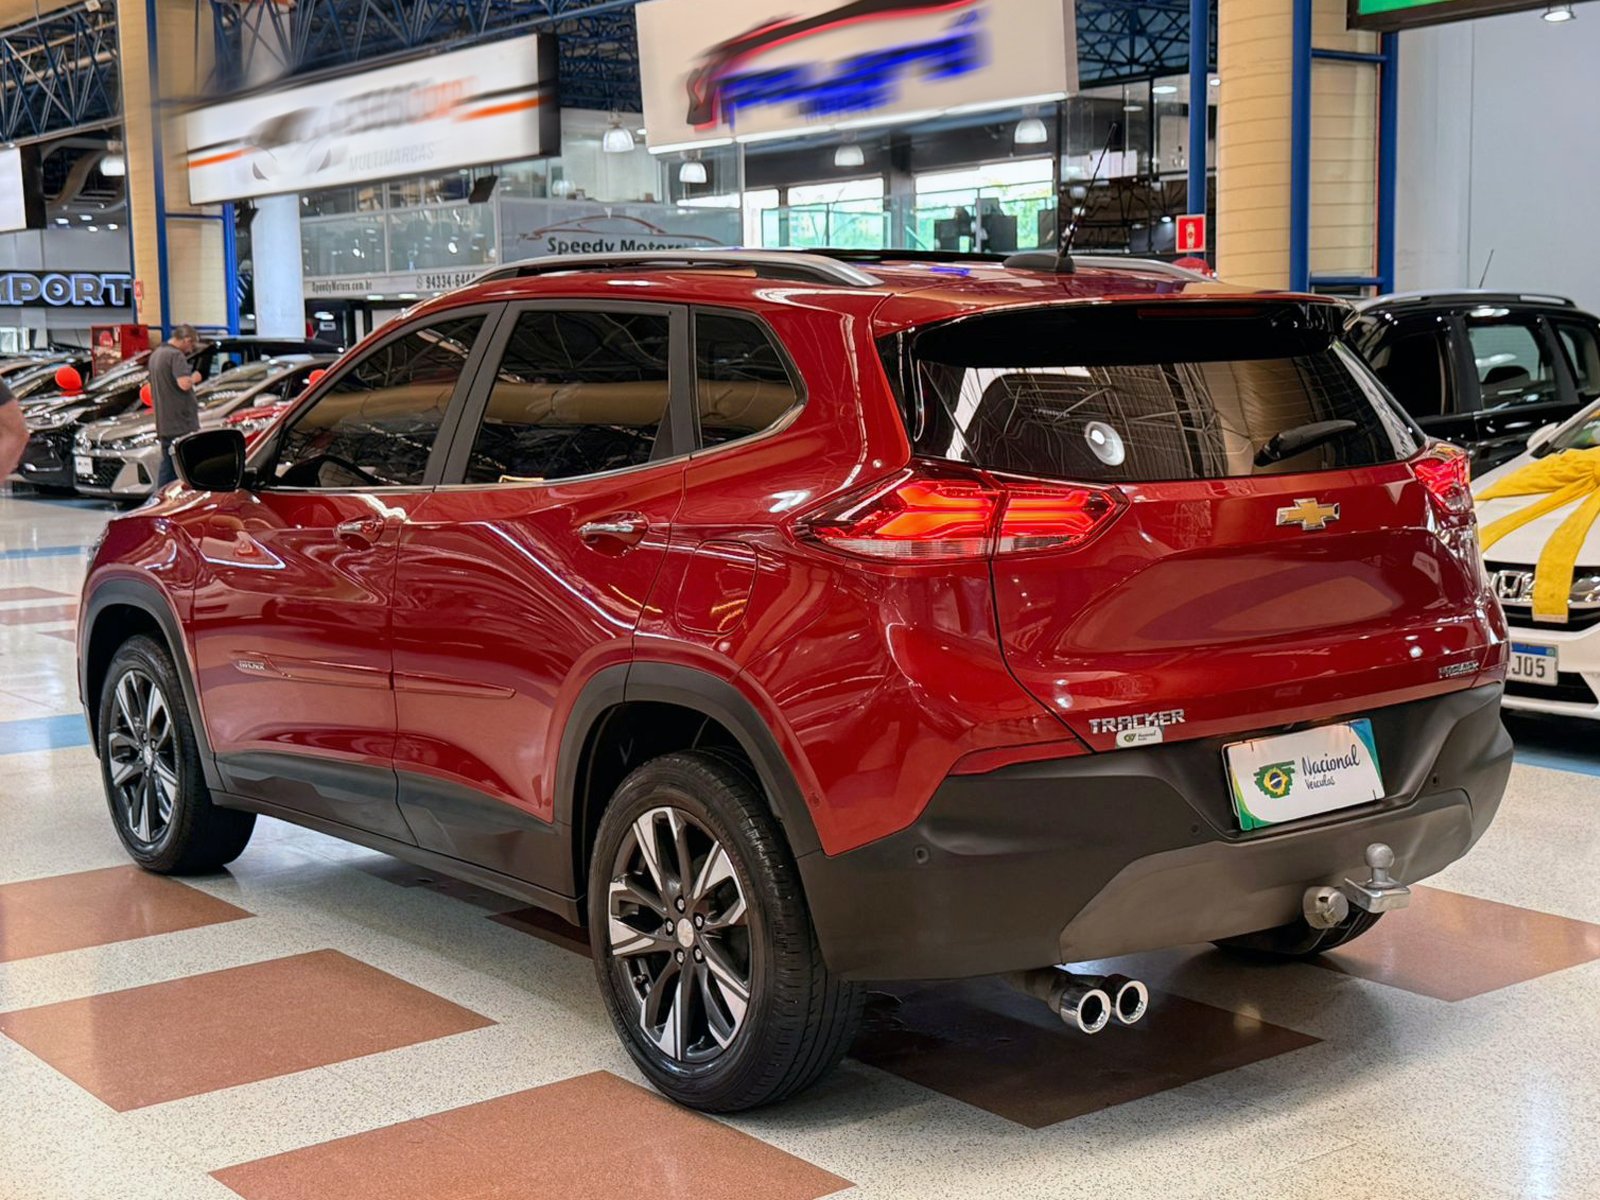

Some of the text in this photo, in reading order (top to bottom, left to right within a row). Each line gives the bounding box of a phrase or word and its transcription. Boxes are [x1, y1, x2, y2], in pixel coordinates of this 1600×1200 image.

[547, 236, 615, 255] Speedy
[0, 273, 132, 306] PORT
[1088, 708, 1186, 734] TRACKER
[1301, 743, 1361, 777] Nacional
